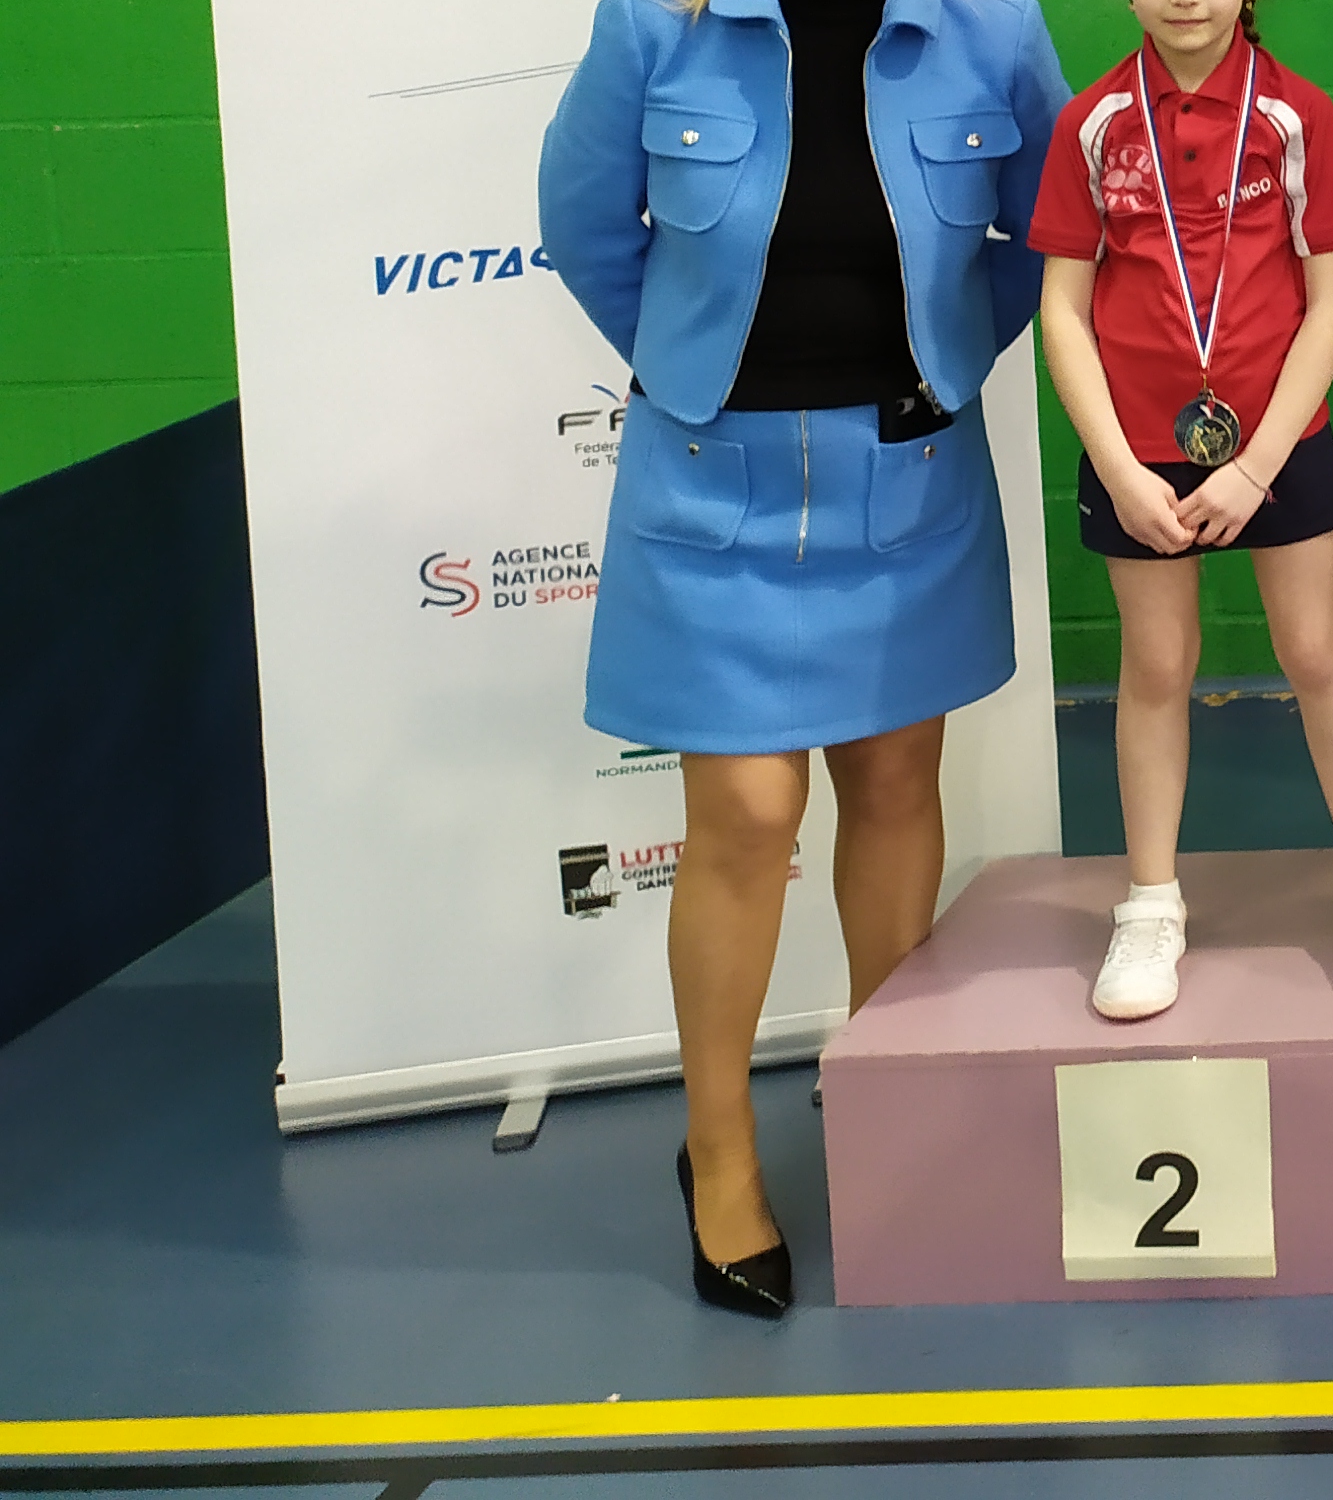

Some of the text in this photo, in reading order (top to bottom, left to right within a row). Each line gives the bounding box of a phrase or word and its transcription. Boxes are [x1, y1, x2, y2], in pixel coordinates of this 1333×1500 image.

[492, 541, 591, 566] AGENCE
[492, 563, 599, 587] NATIONA
[494, 583, 598, 609] DU SPOR
[620, 841, 684, 868] LUTT
[1134, 1152, 1200, 1248] 2
